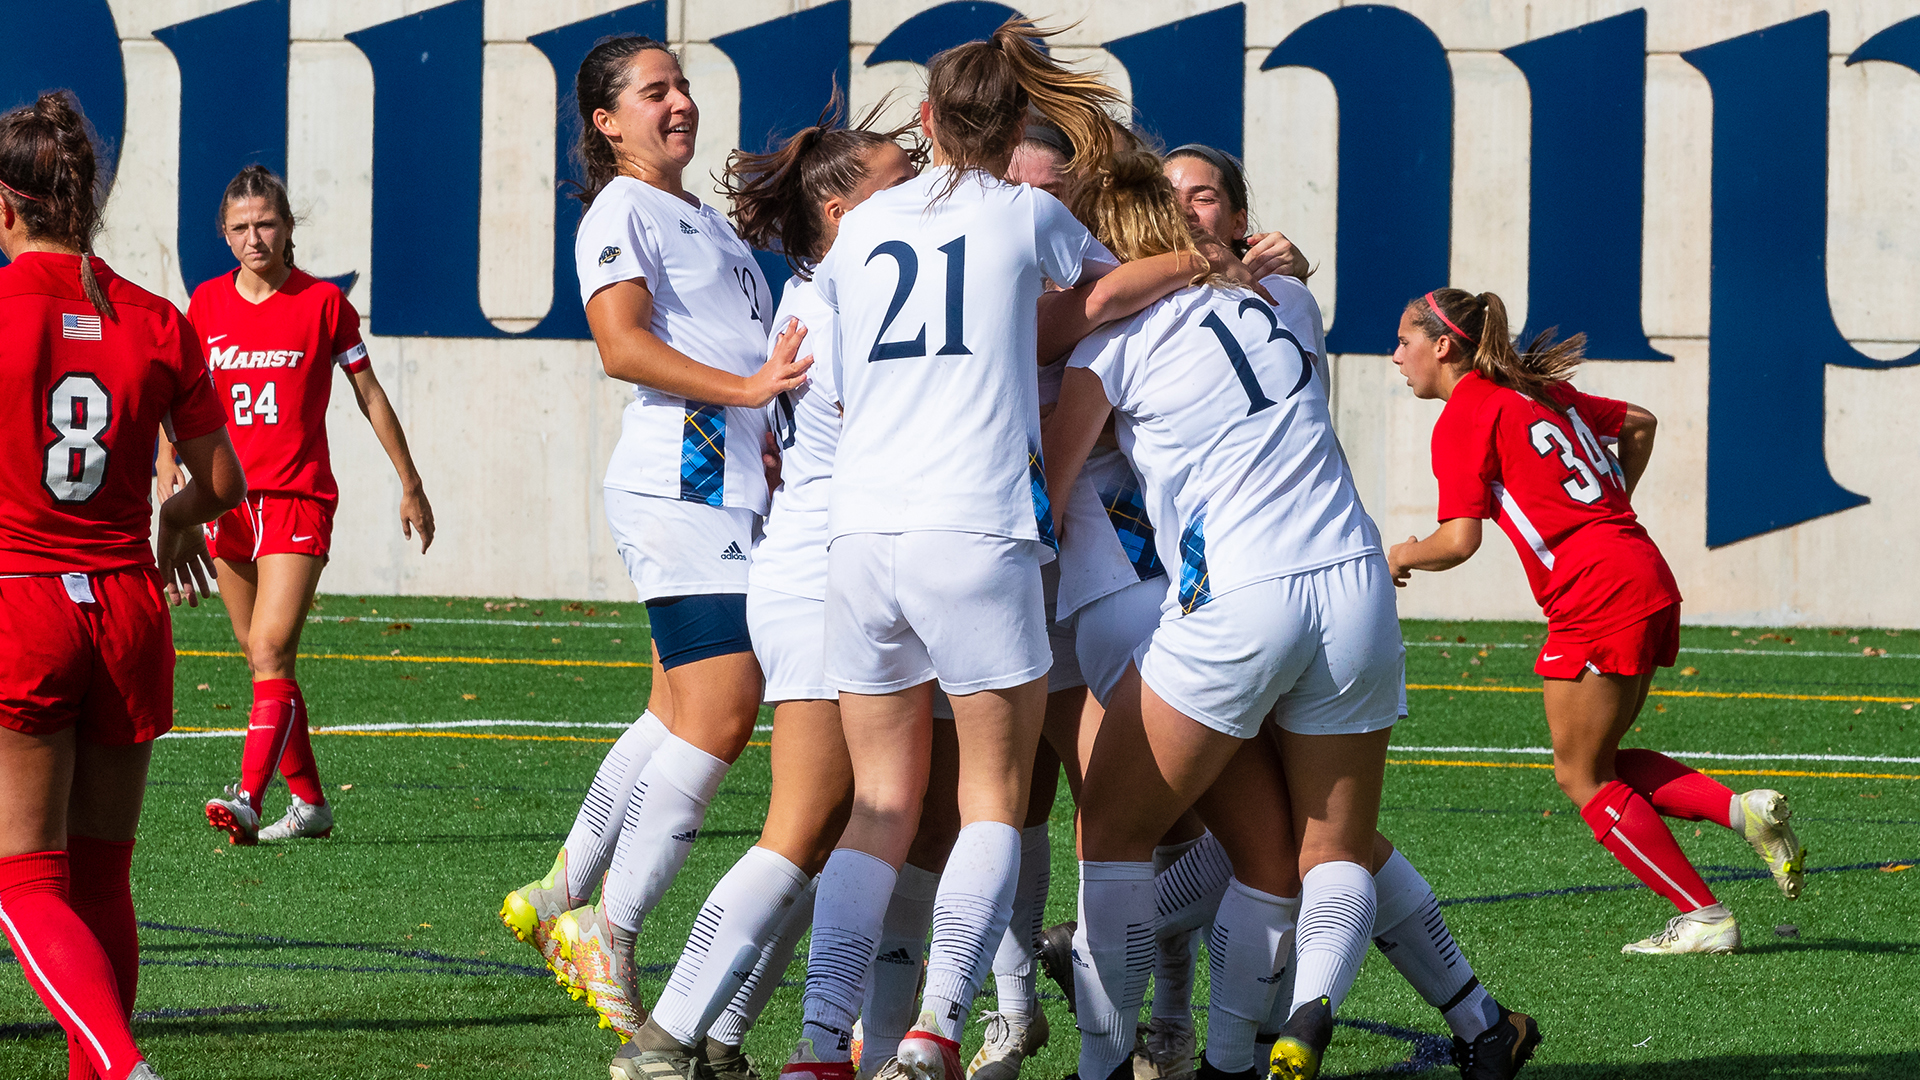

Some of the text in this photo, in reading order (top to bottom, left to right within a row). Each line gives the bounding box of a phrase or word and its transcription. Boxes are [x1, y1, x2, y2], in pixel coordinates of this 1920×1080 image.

[864, 234, 973, 363] 21
[230, 381, 279, 426] 24
[1199, 297, 1313, 417] 13
[41, 371, 113, 505] 8
[1527, 403, 1613, 506] 34
[720, 552, 747, 561] adidas
[876, 955, 915, 965] adidas
